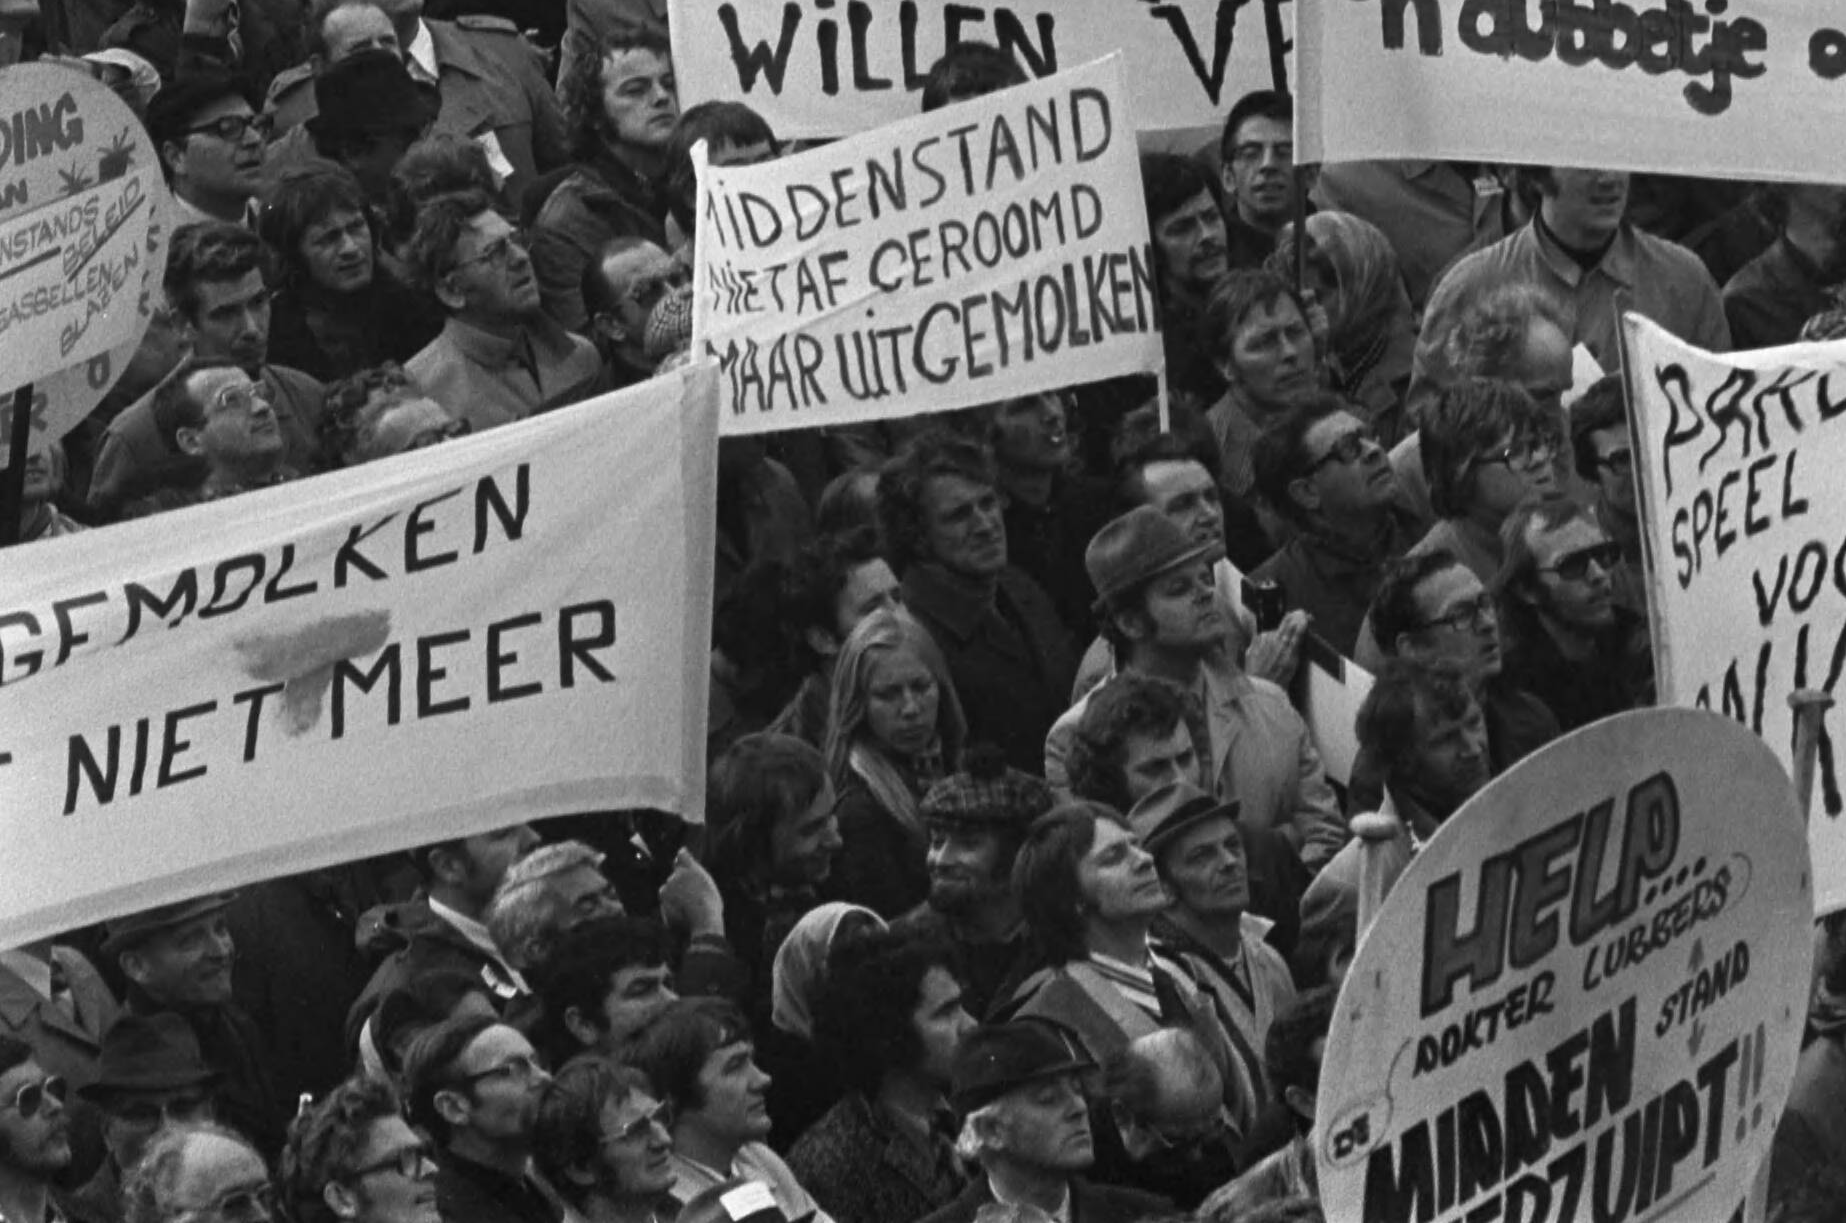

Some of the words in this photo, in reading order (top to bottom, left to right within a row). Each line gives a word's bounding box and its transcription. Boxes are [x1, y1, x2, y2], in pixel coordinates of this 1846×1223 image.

[63, 176, 140, 276] BELEID
[704, 332, 828, 416] MAAR
[1672, 448, 1809, 589] SPEEL
[63, 682, 285, 817] NIET
[330, 599, 617, 740] MEER
[1412, 970, 1556, 1079] DOKTER
[1582, 862, 1735, 992] LUBBERS
[1361, 995, 1637, 1223] MIDDEN
[1655, 940, 1750, 1040] STAND
